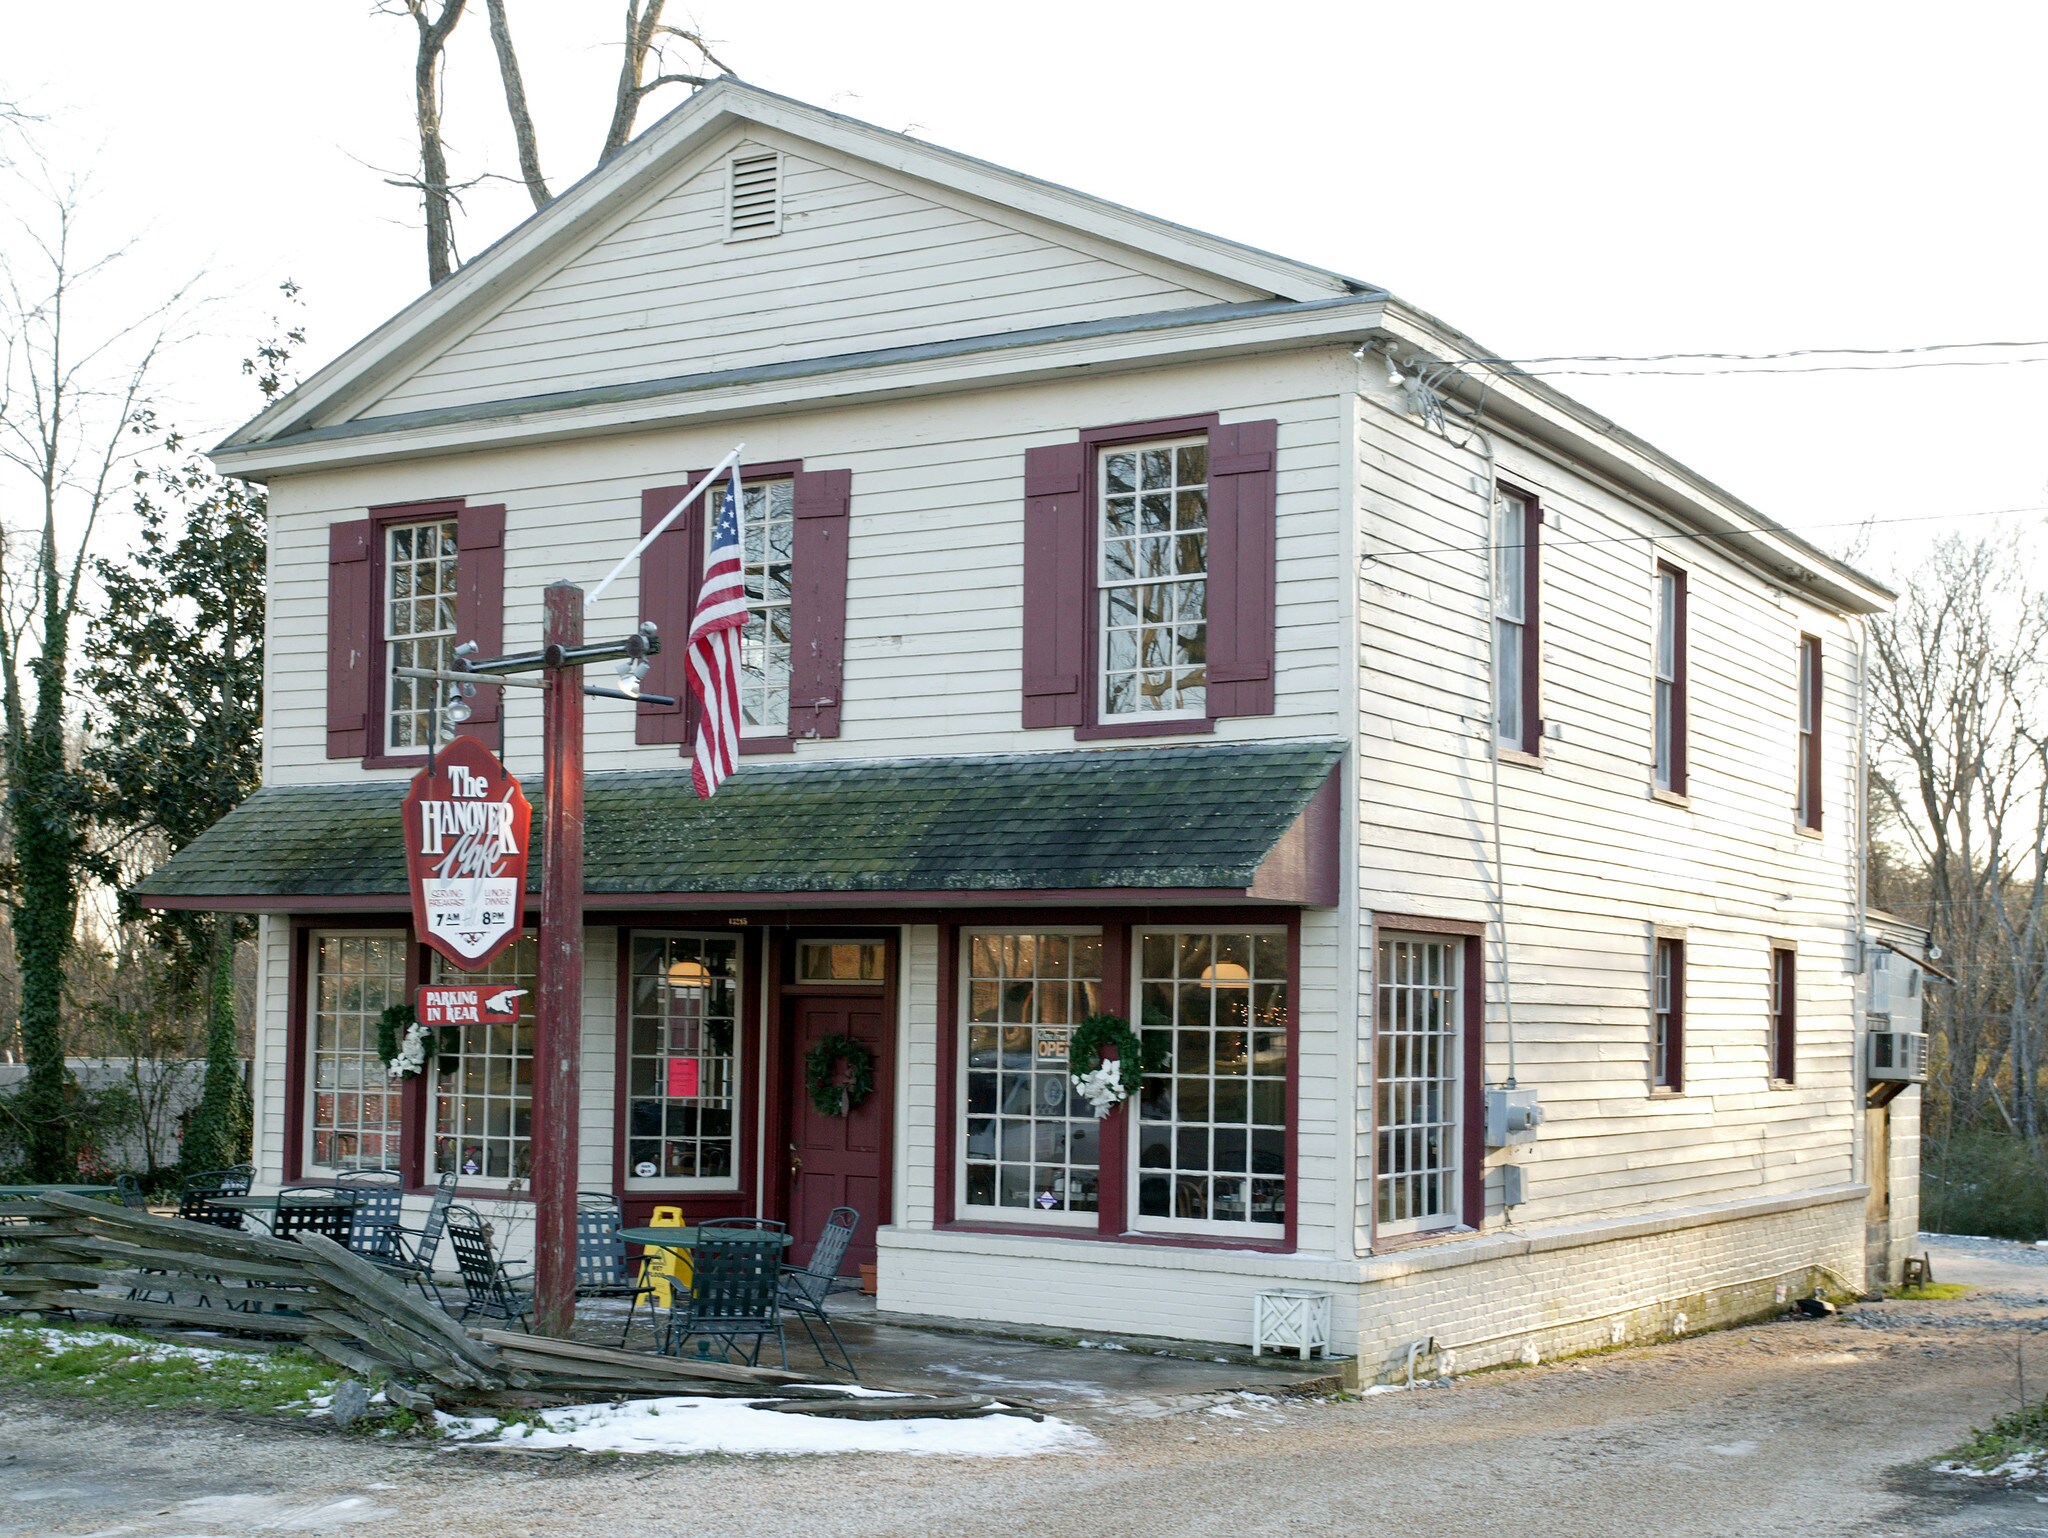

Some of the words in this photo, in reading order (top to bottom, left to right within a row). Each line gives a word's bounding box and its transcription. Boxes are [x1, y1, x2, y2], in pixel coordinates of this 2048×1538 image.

[448, 765, 489, 798] The
[419, 800, 520, 854] HANOVER
[431, 888, 464, 898] SERVING
[429, 898, 466, 907] BREAKFAST
[484, 897, 511, 906] DINNER
[436, 913, 444, 927] 7
[446, 912, 461, 922] AM
[482, 911, 492, 926] 8
[492, 911, 505, 921] PM
[426, 990, 478, 1008] PARKING
[426, 1007, 441, 1021] IN
[445, 1006, 480, 1023] REAR
